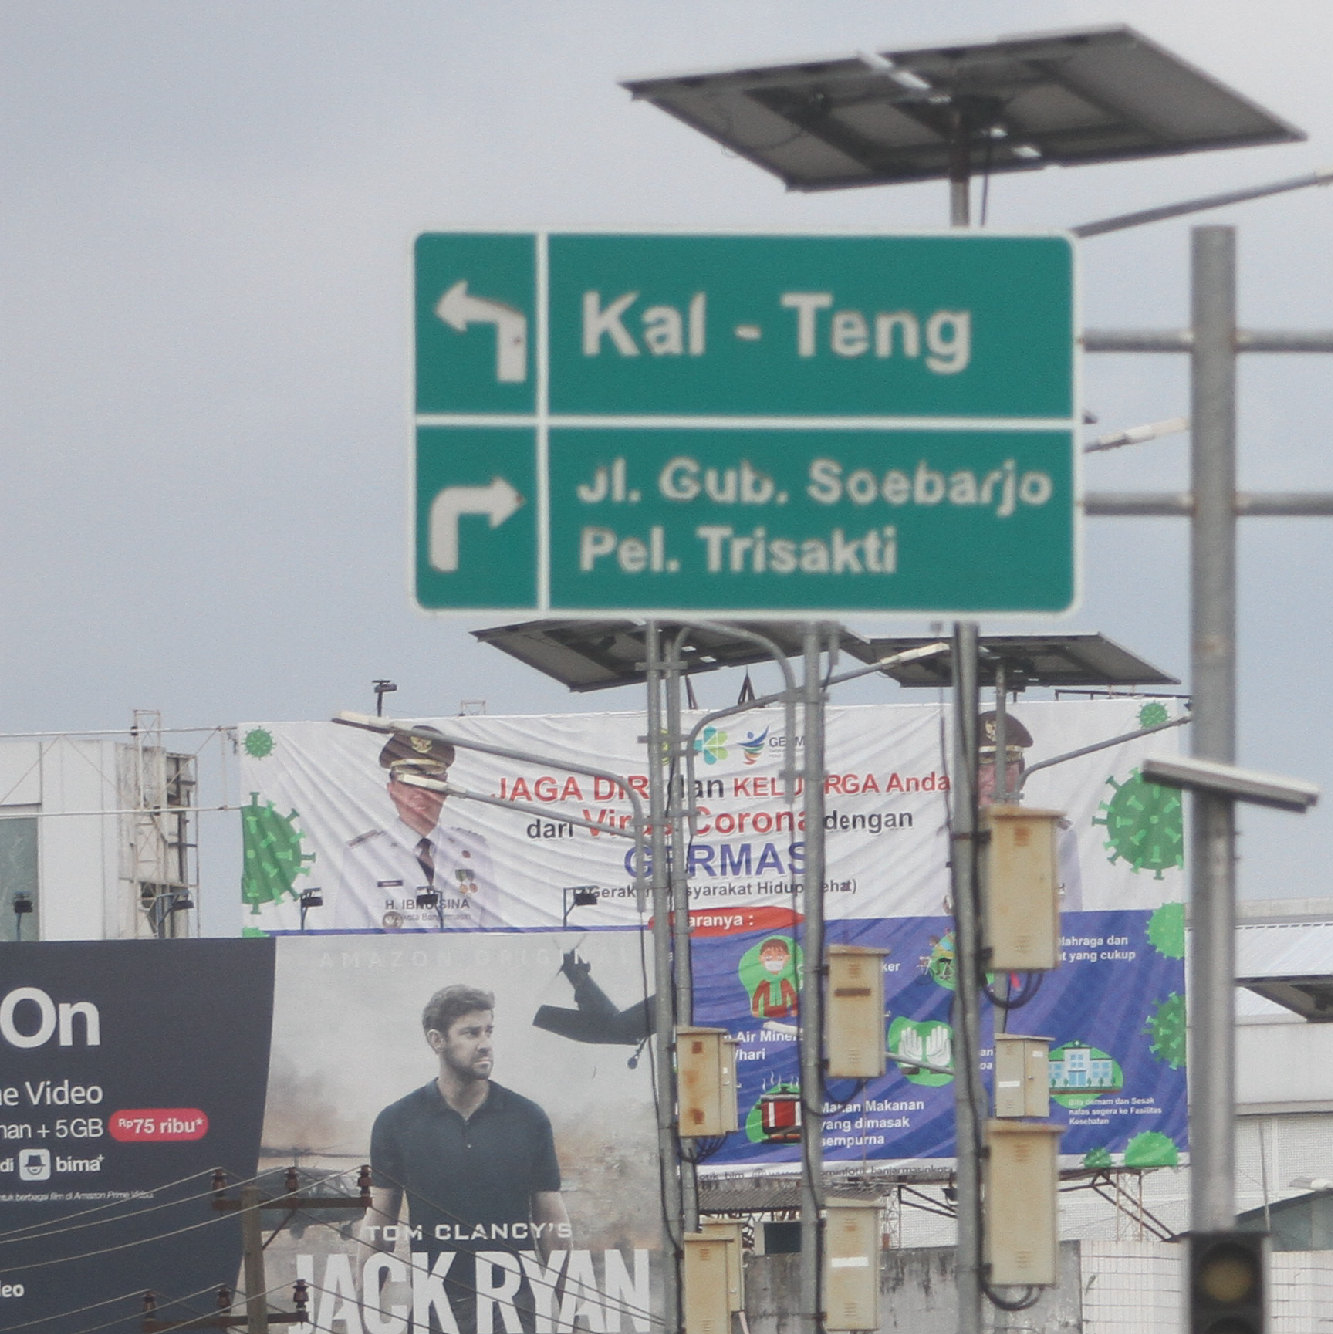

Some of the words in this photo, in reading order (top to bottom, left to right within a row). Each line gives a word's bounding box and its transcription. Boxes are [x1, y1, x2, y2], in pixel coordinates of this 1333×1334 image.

[581, 291, 706, 357] Kal
[734, 325, 762, 340] -
[780, 291, 972, 375] Teng
[576, 457, 641, 504] Jl.
[659, 457, 789, 505] Gub.
[807, 458, 1052, 518] Soebarjo
[580, 525, 679, 573] Pel.
[696, 525, 897, 574] Trisakti
[491, 775, 584, 802] JAGA
[593, 775, 651, 801] DIR
[733, 773, 881, 797] KELURGA
[886, 770, 951, 793] Anda
[526, 818, 574, 838] dari
[825, 809, 913, 834] dengan
[624, 841, 807, 879] GRMAS
[757, 881, 804, 899] Hidup
[823, 880, 857, 896] ehat)
[687, 915, 743, 929] aranya
[1107, 935, 1128, 946] dan
[1069, 951, 1097, 962] yang
[1100, 950, 1136, 962] cukup
[0, 986, 101, 1049] On
[737, 1031, 756, 1043] Air
[25, 1079, 104, 1105] Video
[865, 1099, 925, 1112] Makanan
[854, 1115, 910, 1129] dimasak
[367, 1224, 423, 1242] TOM
[434, 1221, 574, 1242] CLANCY'S
